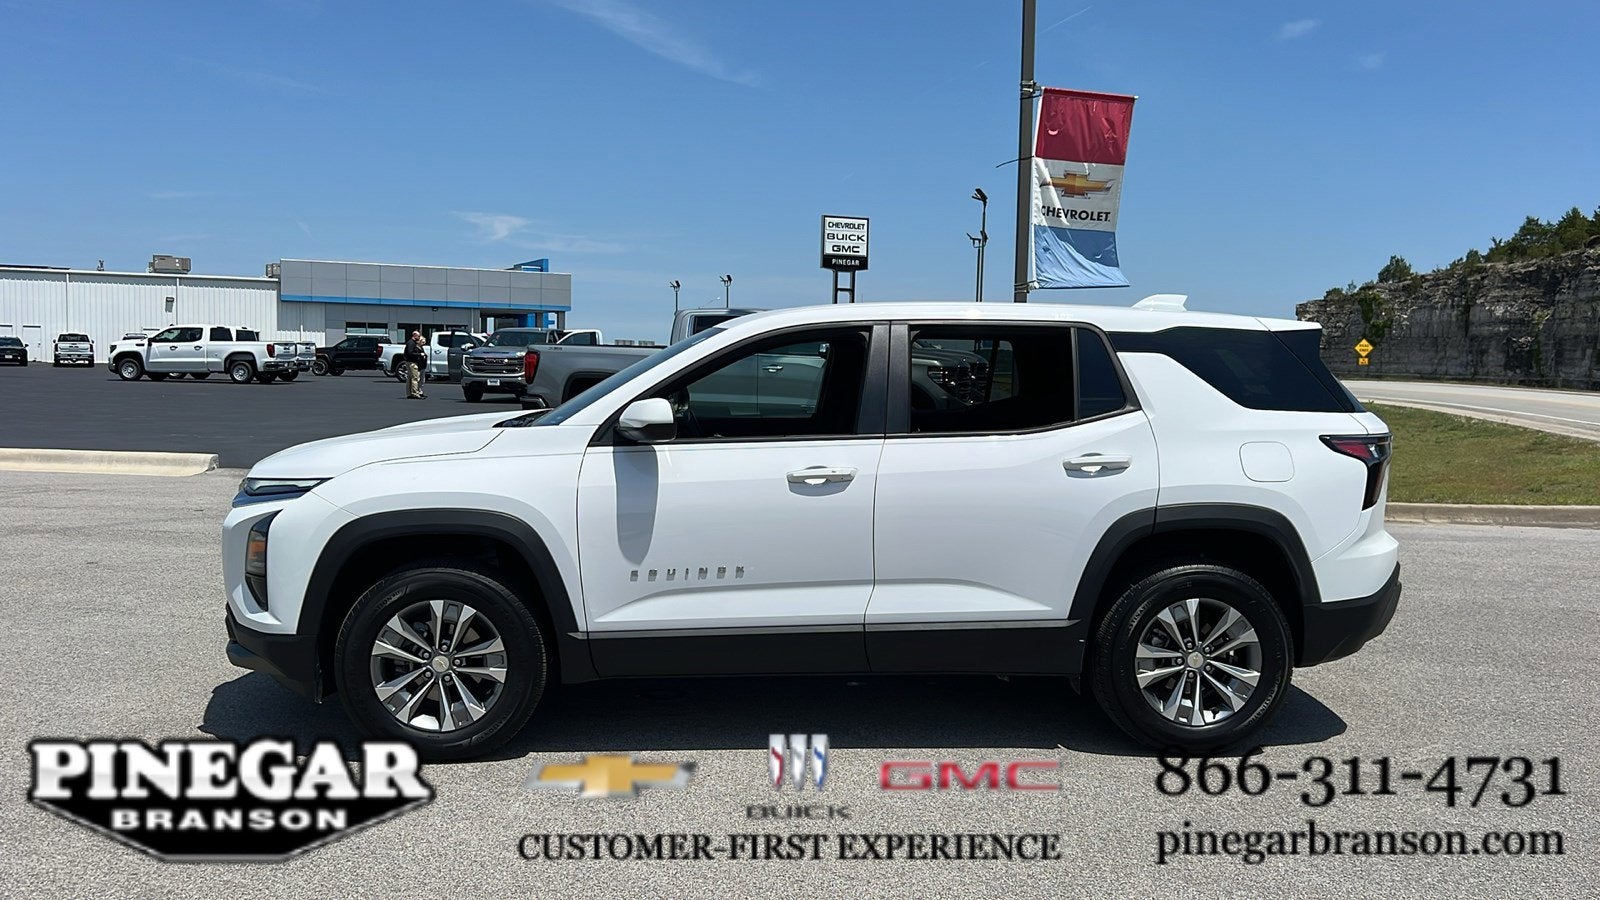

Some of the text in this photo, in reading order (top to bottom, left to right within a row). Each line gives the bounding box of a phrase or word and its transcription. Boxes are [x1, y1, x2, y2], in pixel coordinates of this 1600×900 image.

[827, 221, 866, 230] CHEVROLET
[826, 232, 866, 242] BUICK
[832, 244, 860, 253] GMC
[831, 258, 860, 266] PINEGAR
